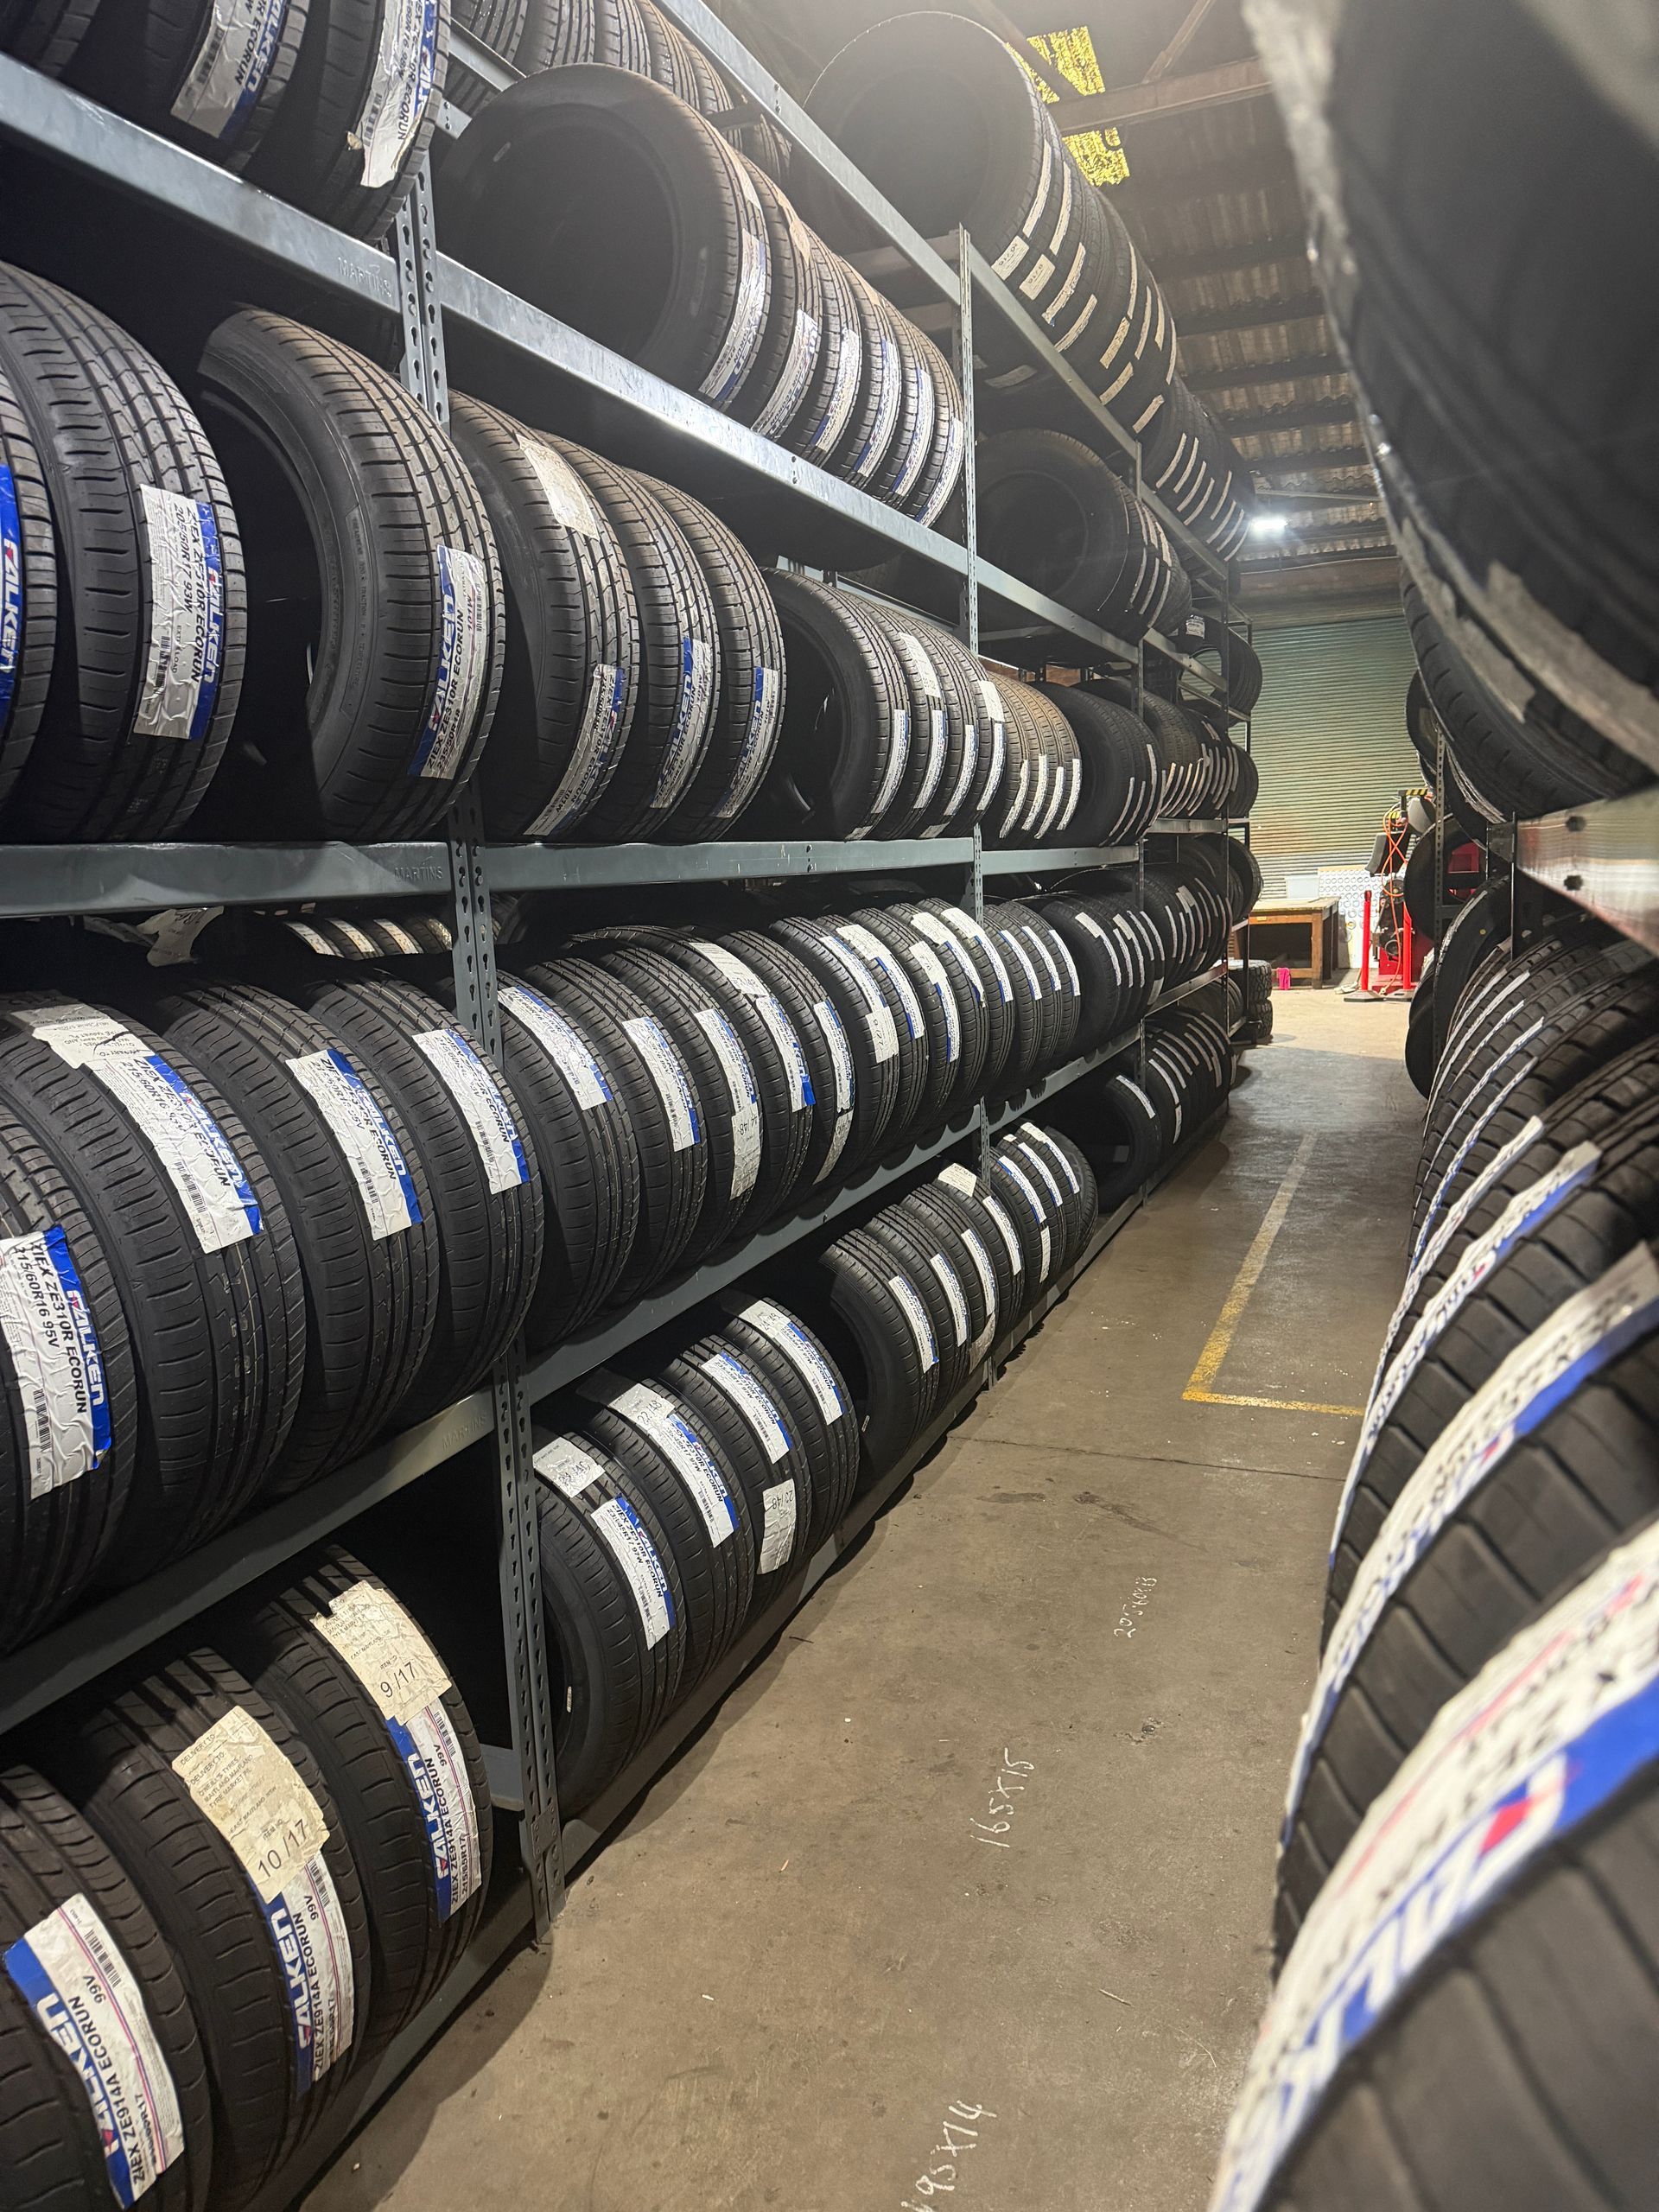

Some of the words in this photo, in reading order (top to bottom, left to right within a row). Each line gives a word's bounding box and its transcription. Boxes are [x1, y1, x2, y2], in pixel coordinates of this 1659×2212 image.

[235, 17, 262, 85] ECORUN
[397, 86, 412, 141] ECORUN
[1, 537, 19, 674] FALKEN
[184, 581, 194, 613] 93W
[466, 593, 474, 632] 101W
[190, 614, 207, 683] ECORUN
[204, 567, 225, 683] FALKEN
[429, 594, 455, 732] FALKEN
[426, 737, 442, 769] ZIEX
[441, 679, 458, 734] ZE310R
[452, 608, 465, 676] ECORUN
[570, 757, 596, 804] ECORUN
[394, 867, 443, 881] MARTINS
[180, 1092, 244, 1189] FALKEN
[486, 1097, 510, 1143] ECORUN
[42, 1319, 60, 1350] 95V
[44, 1281, 74, 1342] ZE310R
[65, 1344, 88, 1414] ECORUN
[66, 1290, 105, 1406] FALKEN
[814, 1363, 833, 1391] ECORUN
[754, 1394, 777, 1426] ECORUN
[694, 1440, 728, 1498] FALKEN
[703, 1466, 724, 1503] ECORUN
[632, 1547, 644, 1565] 97W
[637, 1528, 668, 1592] FALKEN
[645, 1558, 664, 1599] ECORUN
[380, 1681, 394, 1698] 9
[393, 1662, 416, 1690] /17
[180, 1741, 208, 1766] DELIVERY
[189, 1760, 218, 1786] DELIVERY
[433, 1744, 448, 1768] 99V
[203, 1776, 231, 1803] MAITLAND
[208, 1793, 224, 1809] TYRE
[222, 1773, 245, 1797] MARKET
[424, 1758, 450, 1817] ECORUN
[229, 1816, 244, 1834] EAST
[242, 1796, 267, 1821] MAITLAND
[262, 1826, 276, 1841] ITEM
[407, 1752, 450, 1881] FALKEN
[257, 1849, 283, 1878] 10
[282, 1818, 309, 1858] /17
[447, 1819, 460, 1874] ZE914A
[459, 1836, 468, 1896] 215/65R17
[303, 1894, 320, 1922] 99V
[451, 1873, 461, 1905] ZIEX
[292, 1912, 318, 1980] ECORUN
[82, 1974, 107, 2005] 99V
[270, 1906, 314, 2050] FALKEN
[309, 1980, 324, 2039] ZE914A
[67, 1995, 111, 2072] ECORUN
[313, 2039, 324, 2072] ZIEX
[36, 1992, 120, 2158] FALKEN
[105, 2071, 137, 2139] ZE914A
[126, 2146, 146, 2185] ZIEX
